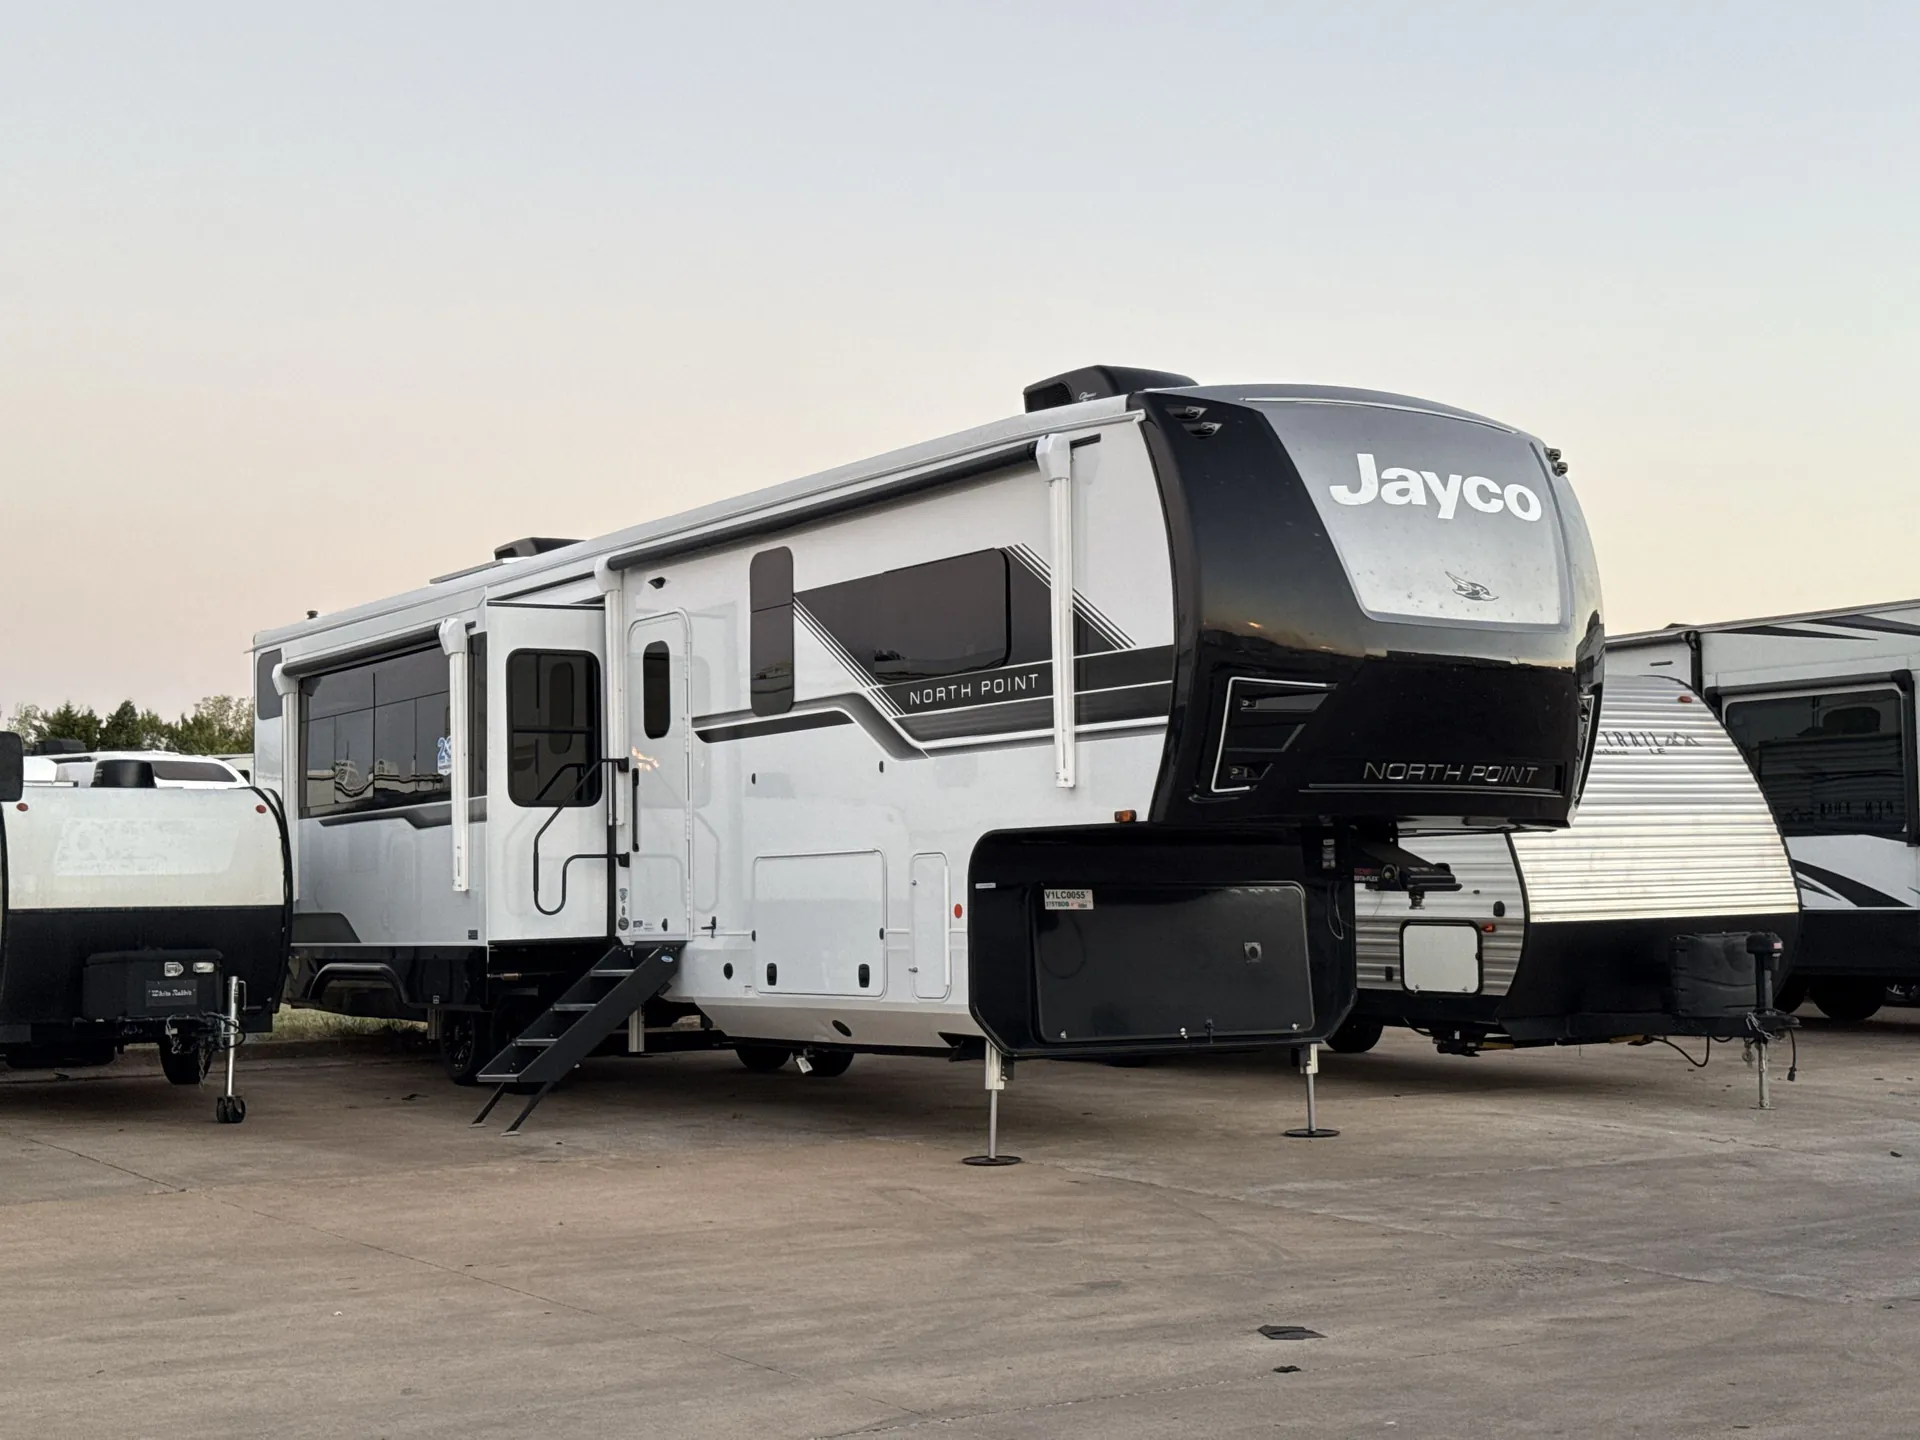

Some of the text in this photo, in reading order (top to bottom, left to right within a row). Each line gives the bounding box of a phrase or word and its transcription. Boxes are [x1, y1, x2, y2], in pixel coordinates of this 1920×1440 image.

[1329, 453, 1542, 522] Jayco
[909, 673, 1039, 706] NORTH POINT
[1599, 731, 1663, 747] TRAIL
[1648, 747, 1667, 755] LE
[1363, 762, 1539, 783] NORTH POINT
[1045, 890, 1086, 899] V1LC0055
